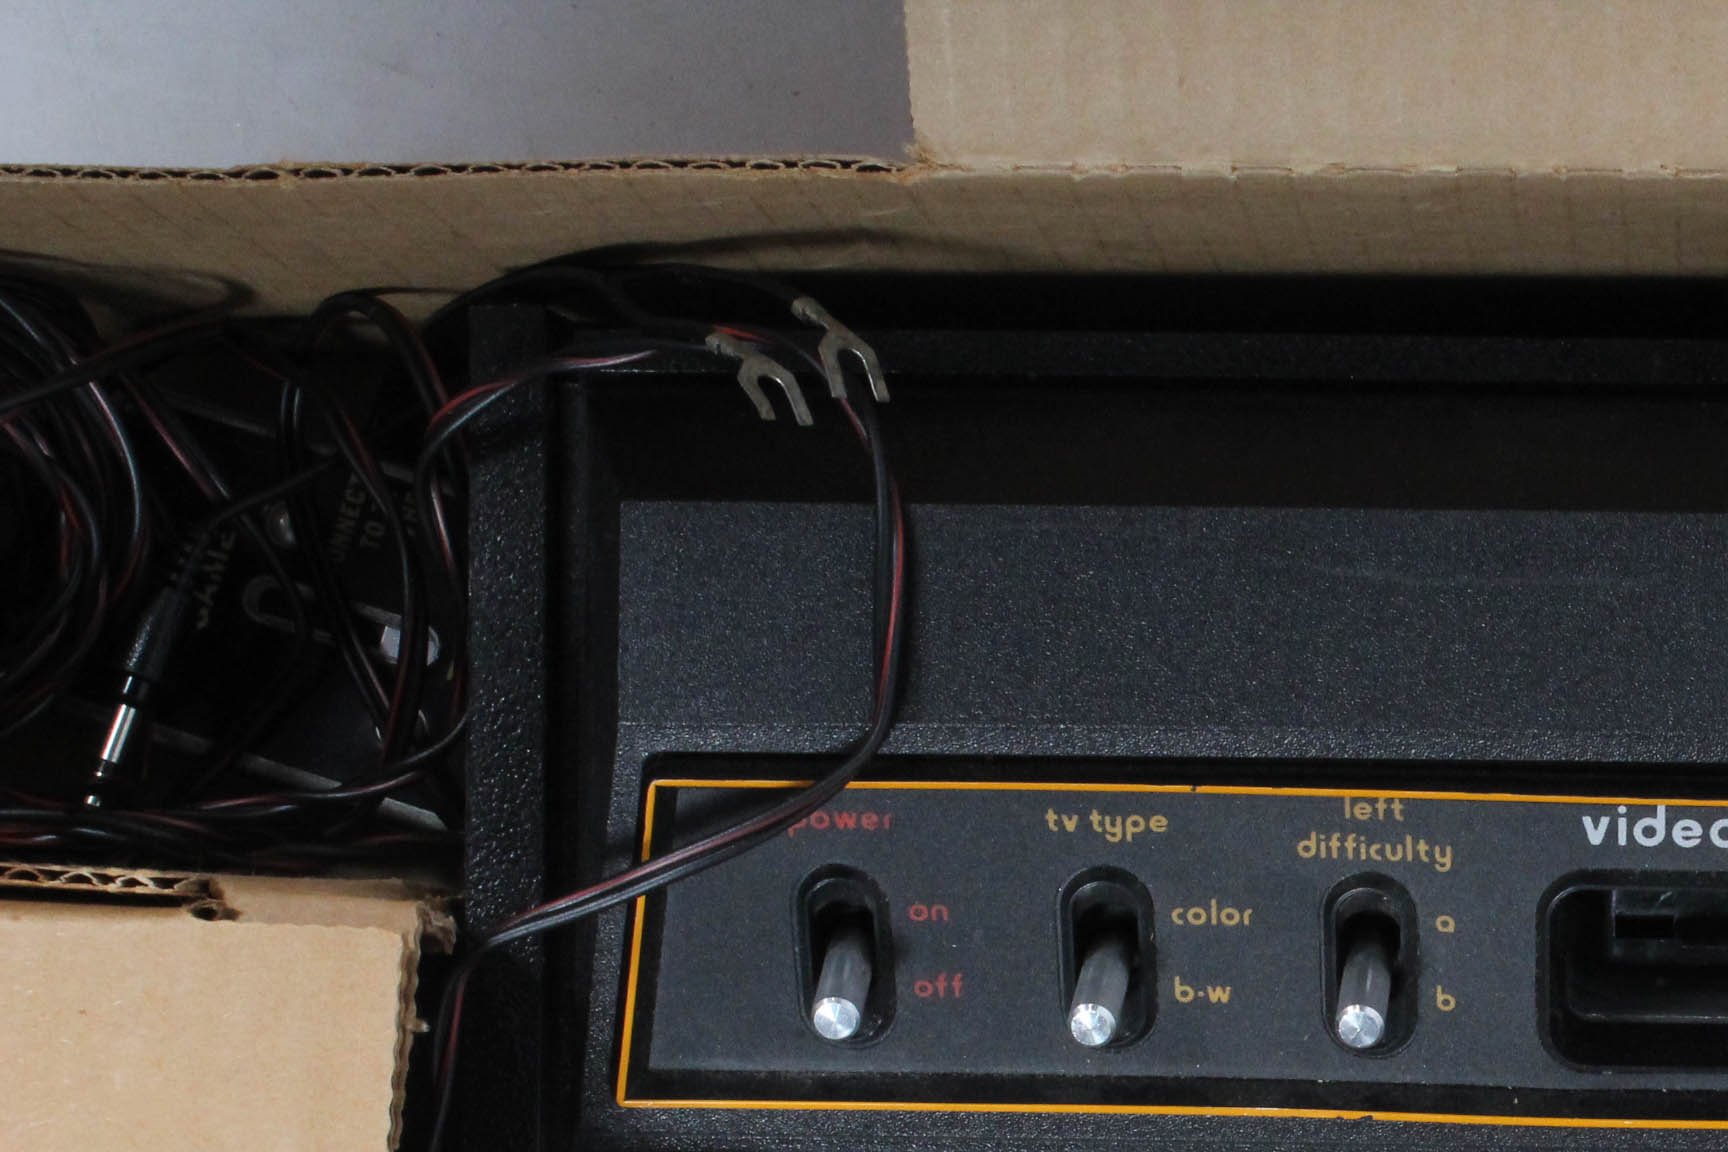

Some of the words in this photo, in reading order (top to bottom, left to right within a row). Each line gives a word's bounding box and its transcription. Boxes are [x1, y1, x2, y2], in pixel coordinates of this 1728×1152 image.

[1343, 796, 1404, 820] left
[1045, 808, 1079, 832] tv
[1089, 809, 1169, 842] type
[1297, 832, 1452, 872] difficulty
[909, 904, 949, 921] on
[1171, 899, 1253, 926] color
[1435, 915, 1456, 933] a
[914, 973, 965, 998] off
[1436, 985, 1456, 1011] b
